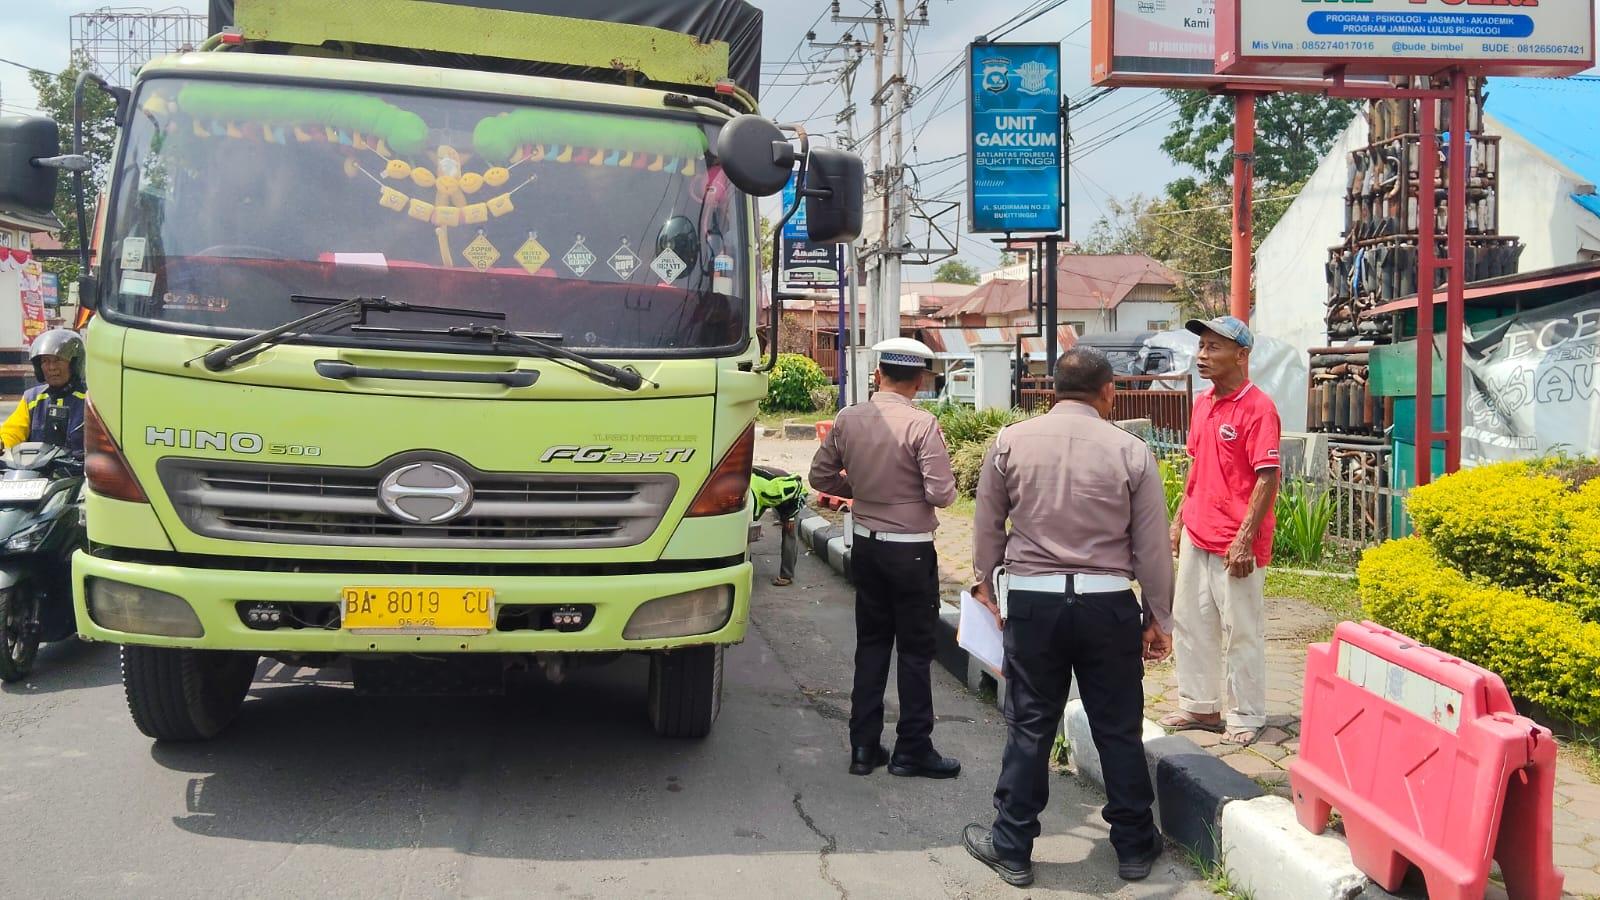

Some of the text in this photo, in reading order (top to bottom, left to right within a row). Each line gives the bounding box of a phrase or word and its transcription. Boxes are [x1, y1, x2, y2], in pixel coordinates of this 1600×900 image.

[1184, 18, 1210, 28] Kami
[1326, 14, 1369, 22] PROGRAM
[1428, 16, 1464, 24] JASMANI
[1388, 25, 1427, 33] JAMINAN
[1428, 26, 1454, 34] LULUS
[1252, 41, 1269, 50] Mis
[1272, 41, 1293, 50] Vina
[1302, 42, 1374, 50] 085274017016
[1482, 44, 1509, 53] BUDE
[1517, 44, 1584, 54] 081265067421
[996, 116, 1036, 130] UNIT
[976, 132, 1056, 147] GAKKUM
[146, 426, 321, 456] HINO 500
[347, 591, 489, 614] BA 8019 CU
